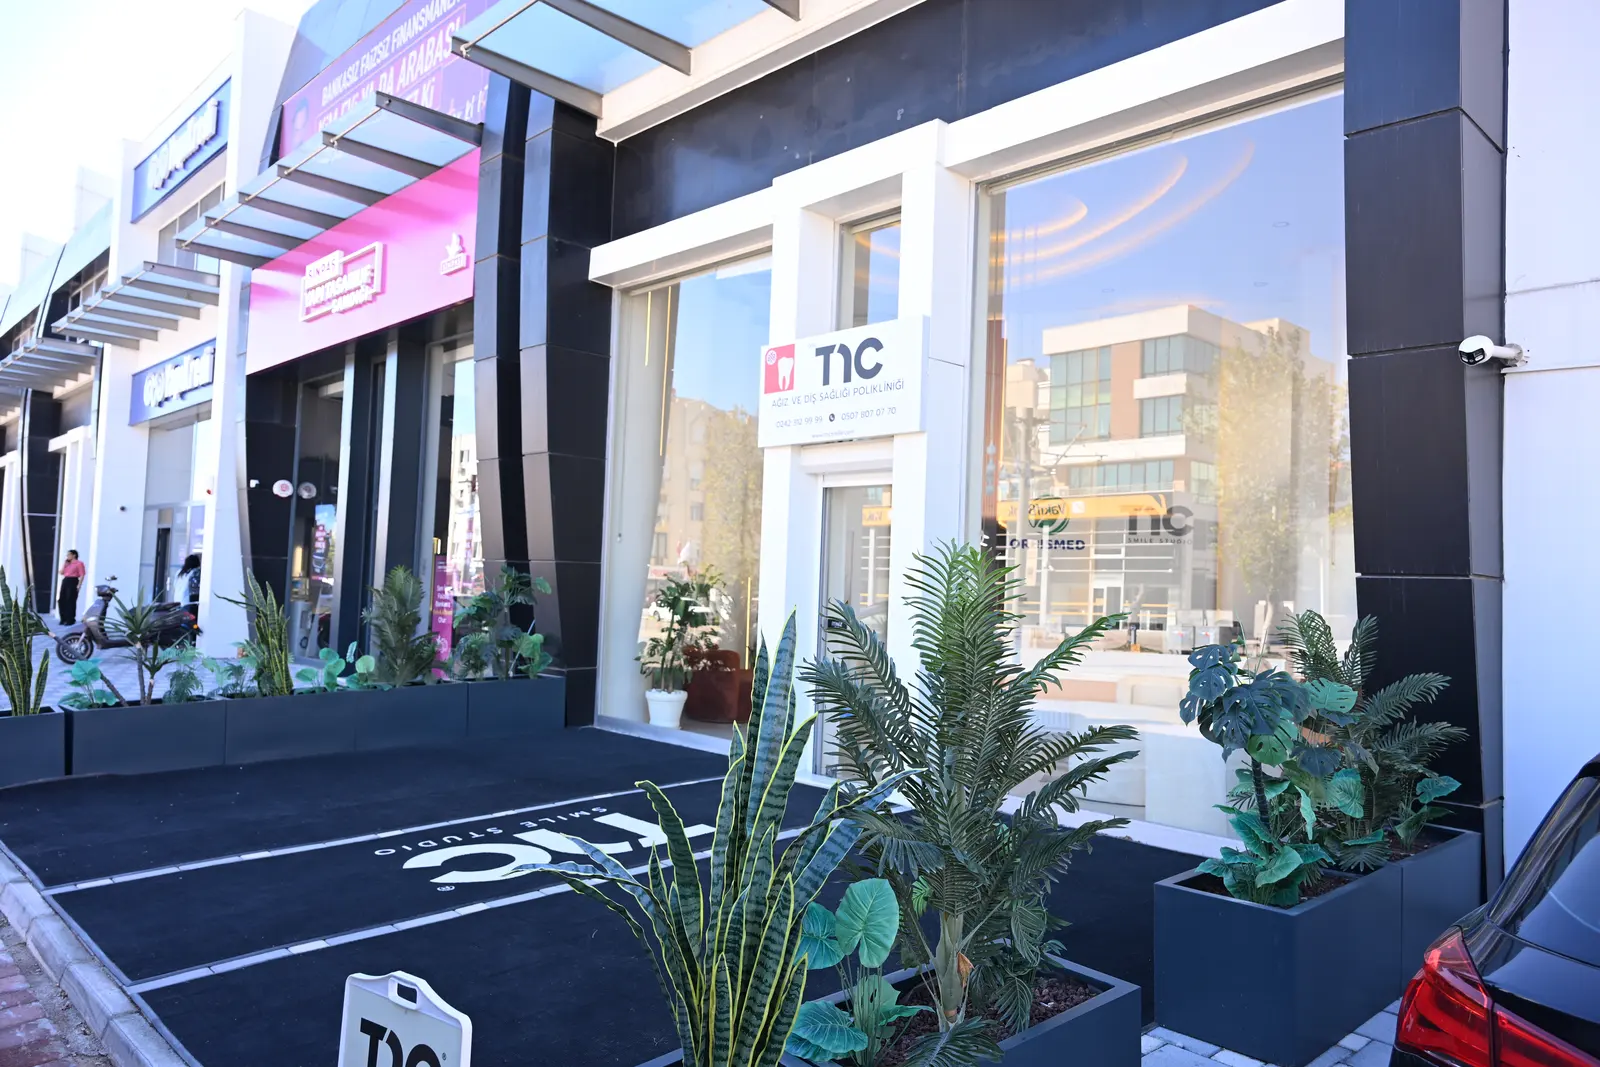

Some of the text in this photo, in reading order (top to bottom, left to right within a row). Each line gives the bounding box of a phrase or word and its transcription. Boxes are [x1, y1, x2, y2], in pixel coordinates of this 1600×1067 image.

[792, 395, 801, 405] VE
[374, 806, 607, 856] SMILE STUDIO
